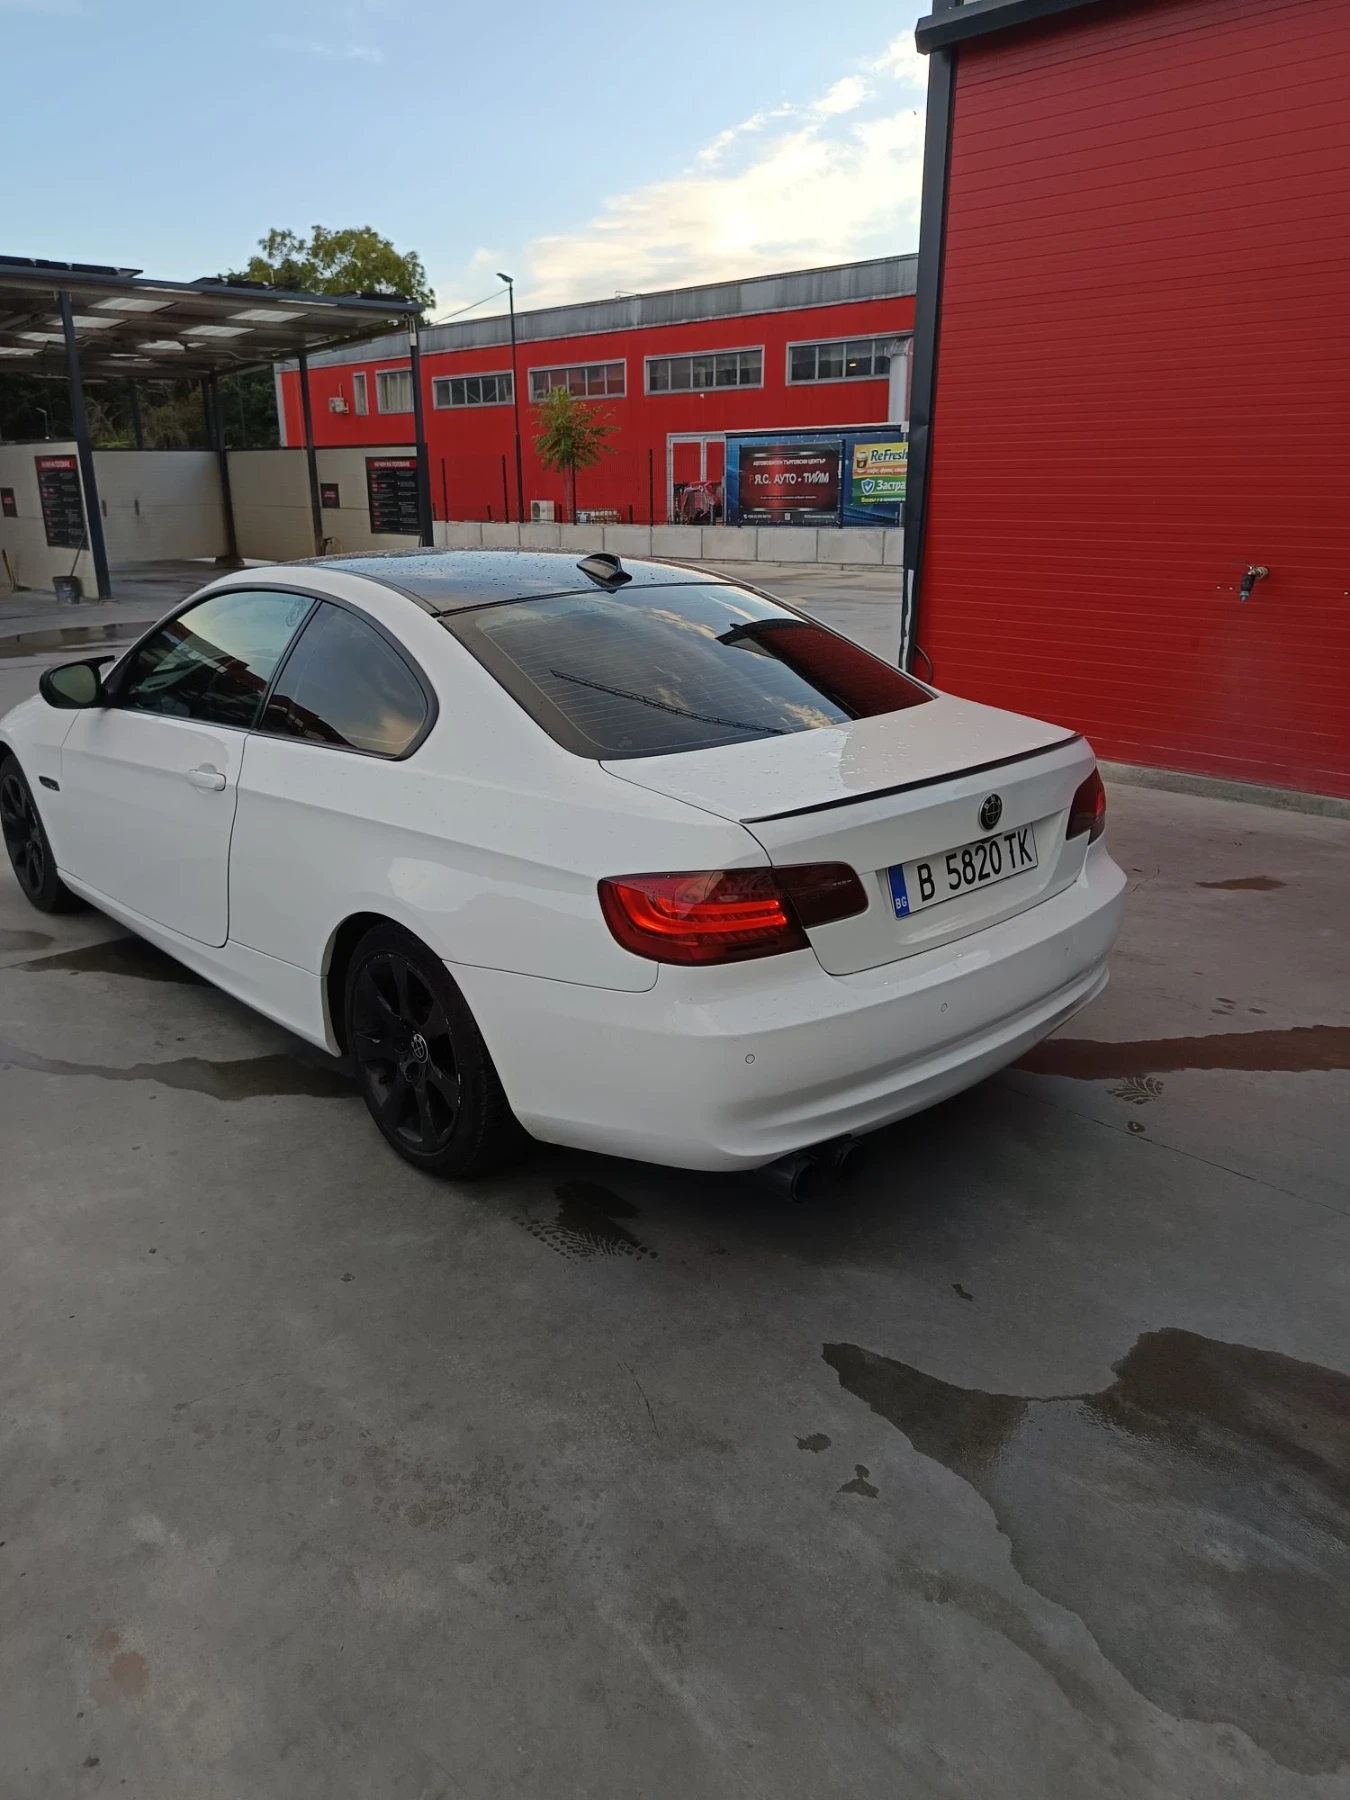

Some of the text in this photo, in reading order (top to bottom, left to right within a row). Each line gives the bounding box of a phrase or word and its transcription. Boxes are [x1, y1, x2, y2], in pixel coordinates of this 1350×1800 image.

[871, 448, 908, 461] ReFresh
[774, 473, 796, 484] АУТО
[803, 471, 829, 484] ТИЙМ
[917, 828, 1033, 902] B 5820 TK
[895, 896, 907, 910] BG
